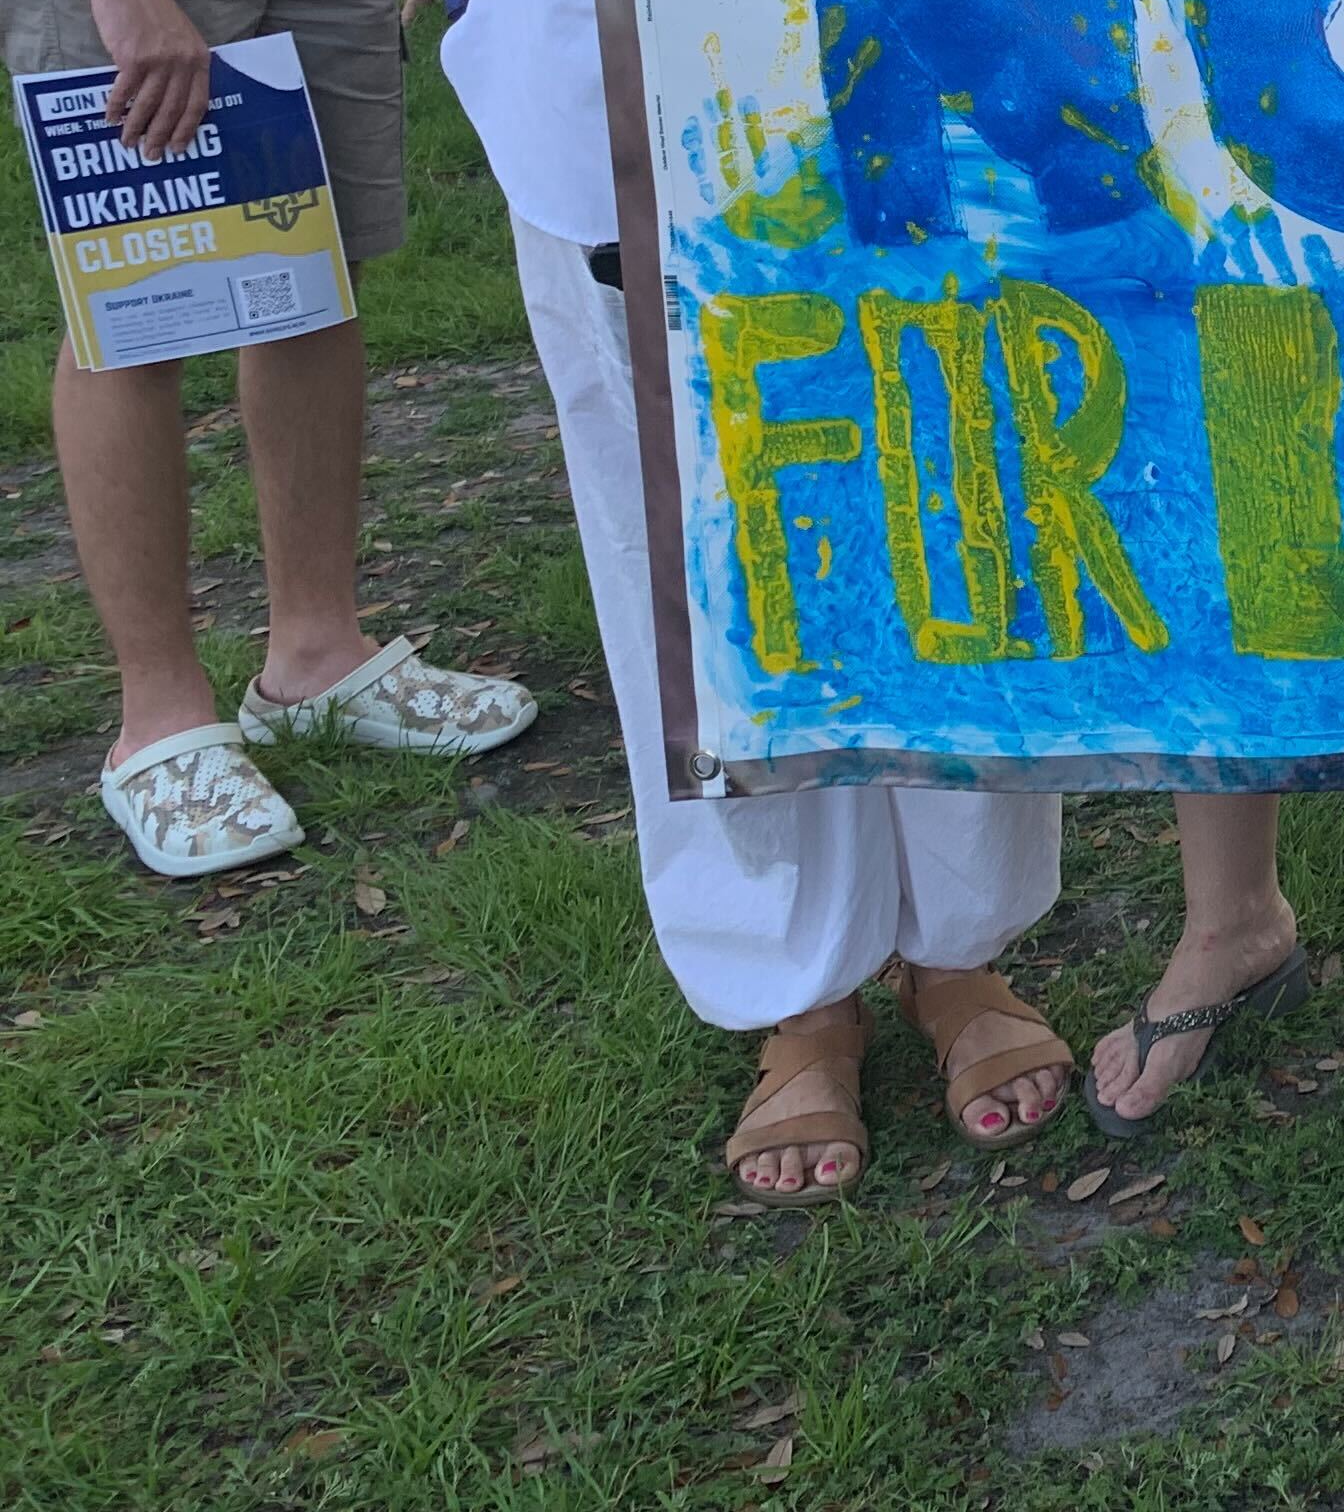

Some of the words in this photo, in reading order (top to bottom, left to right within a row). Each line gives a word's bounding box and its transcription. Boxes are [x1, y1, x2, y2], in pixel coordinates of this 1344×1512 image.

[51, 93, 96, 114] JOIN
[63, 171, 226, 229] UKRAINE
[76, 221, 216, 273] CLOSER
[698, 278, 1171, 674] FOR
